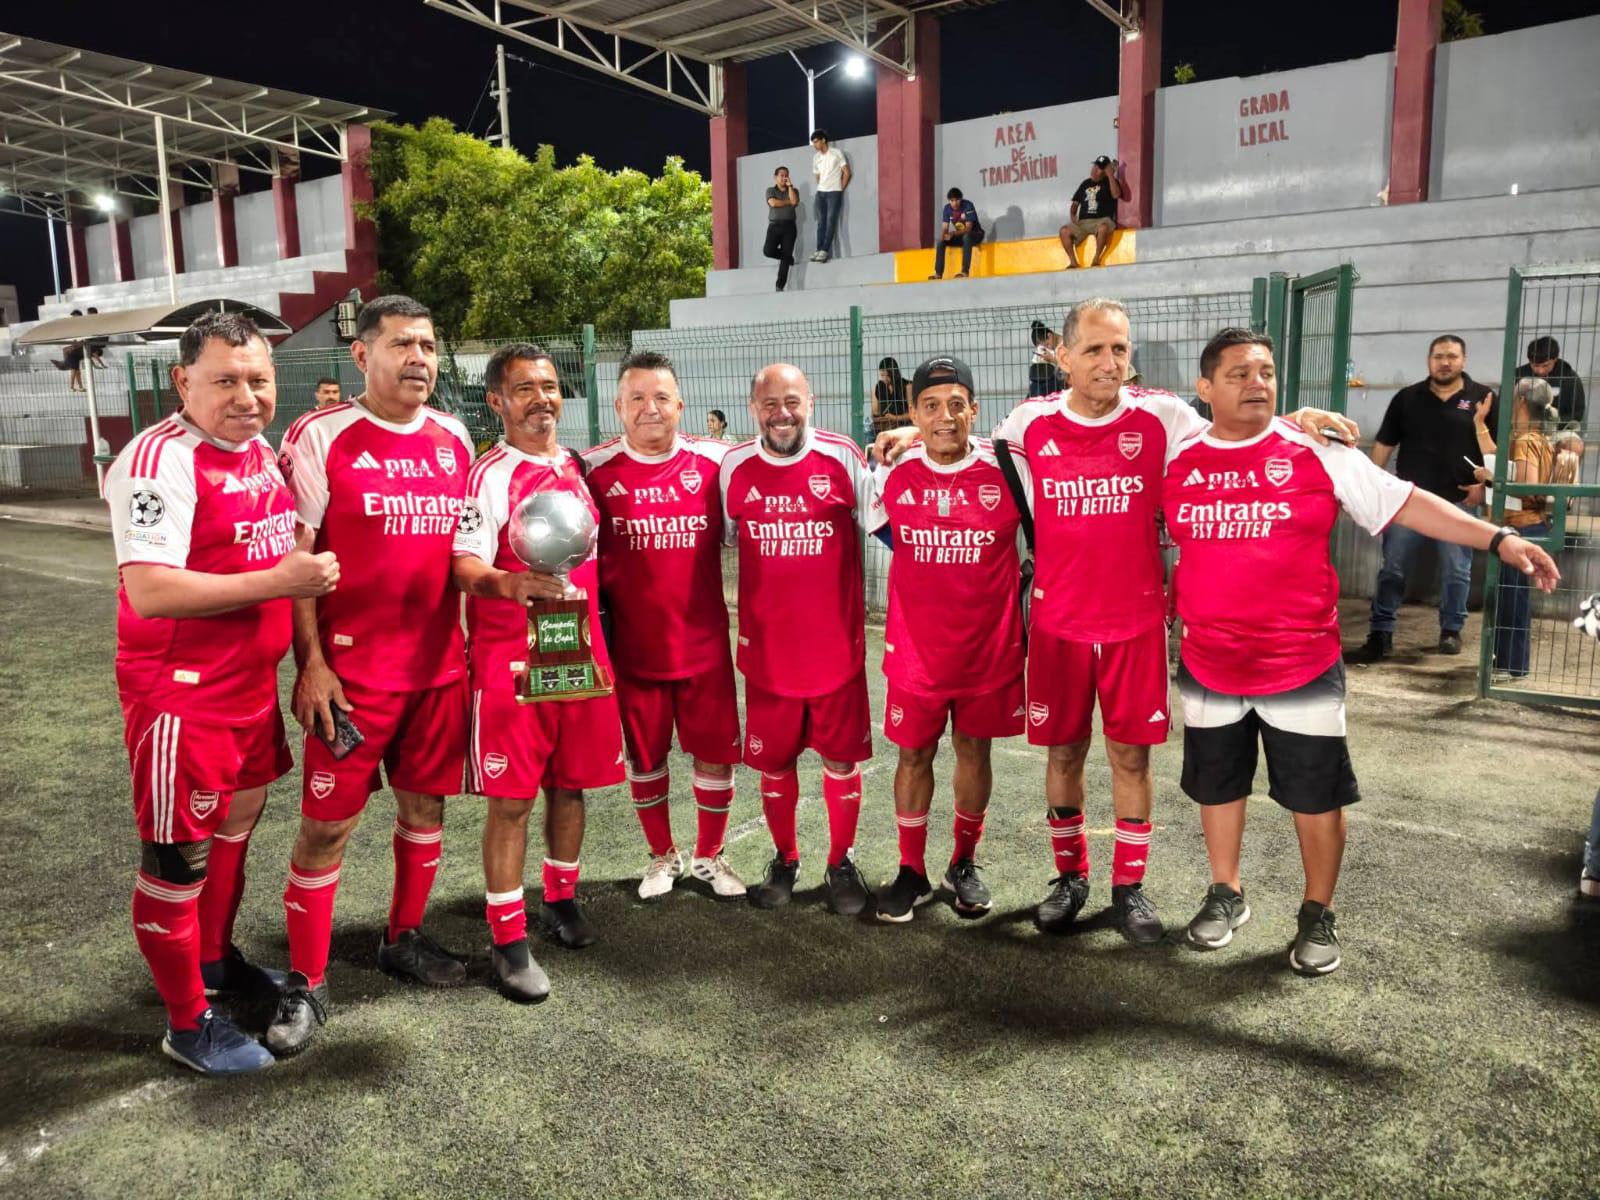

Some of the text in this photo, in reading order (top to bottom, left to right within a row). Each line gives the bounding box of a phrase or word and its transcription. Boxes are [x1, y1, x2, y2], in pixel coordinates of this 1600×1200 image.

[1240, 90, 1290, 117] GRADA
[994, 120, 1037, 148] AREA
[1011, 145, 1027, 162] DE
[1042, 474, 1144, 499] Emirates
[362, 491, 465, 516] Emirates
[765, 496, 808, 513] PRA
[1057, 495, 1130, 517] FLY BETTER
[1177, 500, 1292, 523] Emirates
[233, 509, 298, 544] Emirate
[384, 516, 454, 535] FLY BETTER
[612, 514, 709, 536] Emirates
[746, 518, 834, 539] Emirates
[900, 525, 996, 546] Emirates
[1192, 521, 1272, 539] FLY BETTER
[247, 539, 268, 561] FLY
[630, 532, 696, 551] FLY BETTER
[760, 539, 823, 556] FLY BETTER
[914, 546, 981, 564] FLY BETTER
